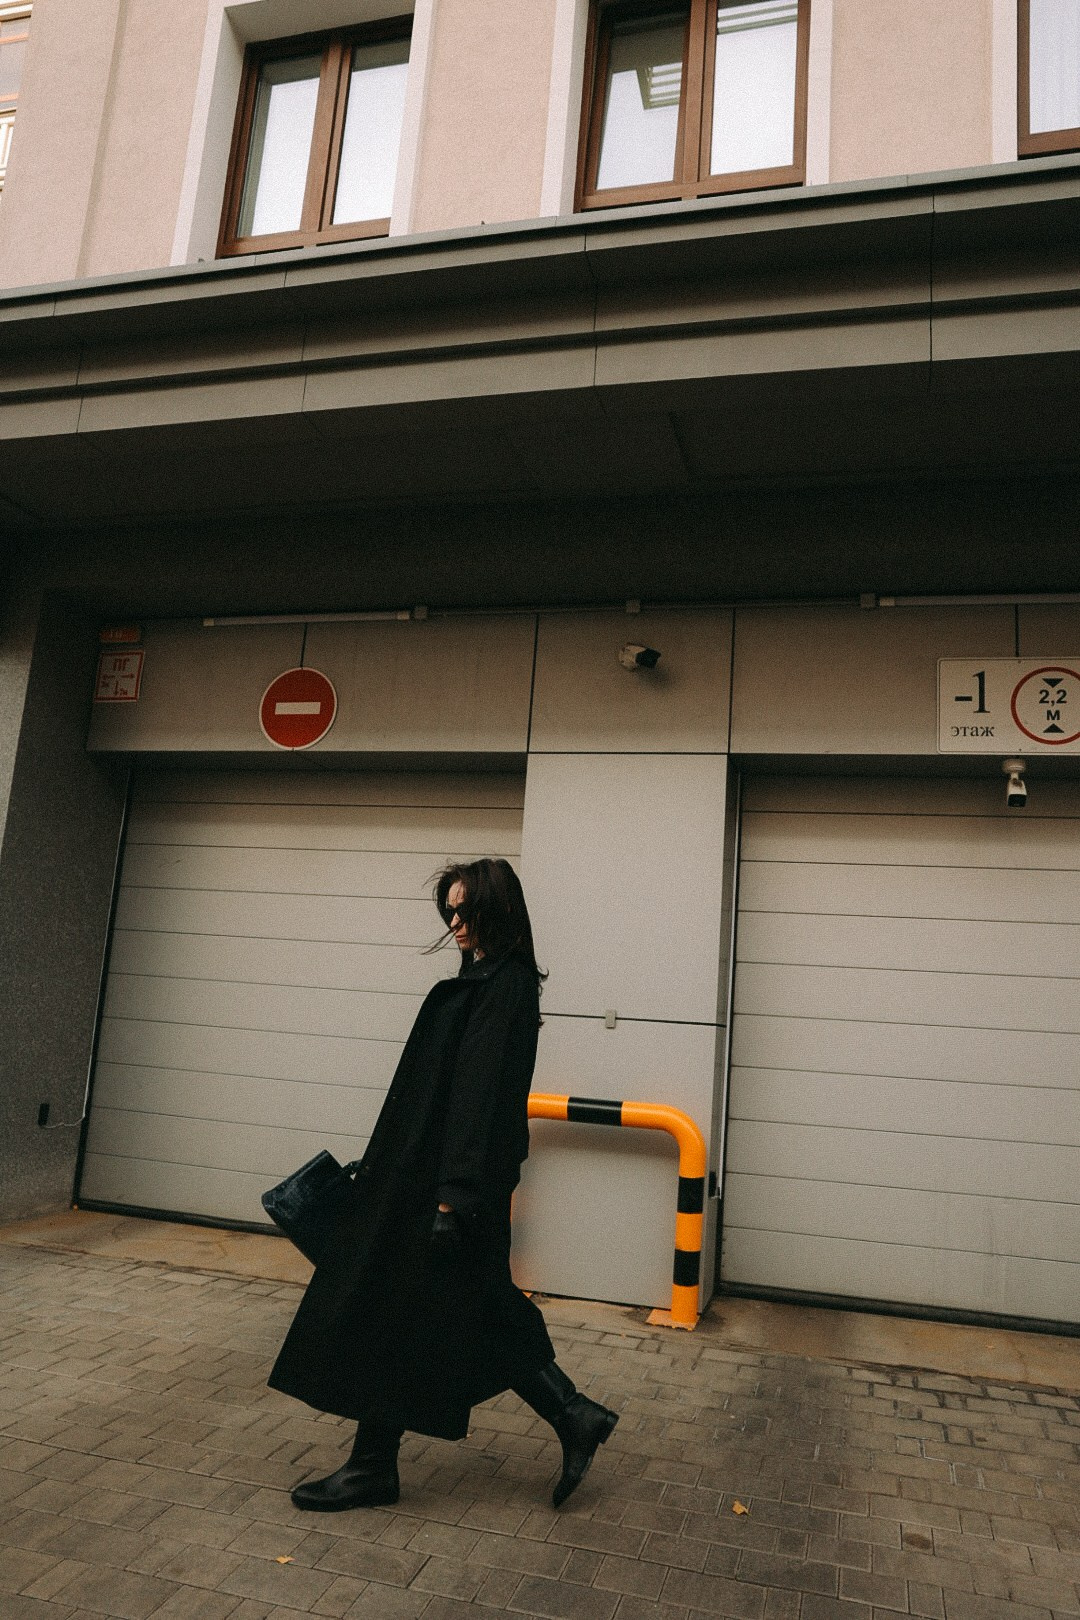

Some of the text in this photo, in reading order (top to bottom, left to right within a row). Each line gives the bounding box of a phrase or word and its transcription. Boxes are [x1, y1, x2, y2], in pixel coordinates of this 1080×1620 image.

[113, 658, 130, 671] ПГ
[955, 670, 991, 714] -1
[1039, 689, 1067, 706] 2,2
[951, 725, 995, 737] этаж
